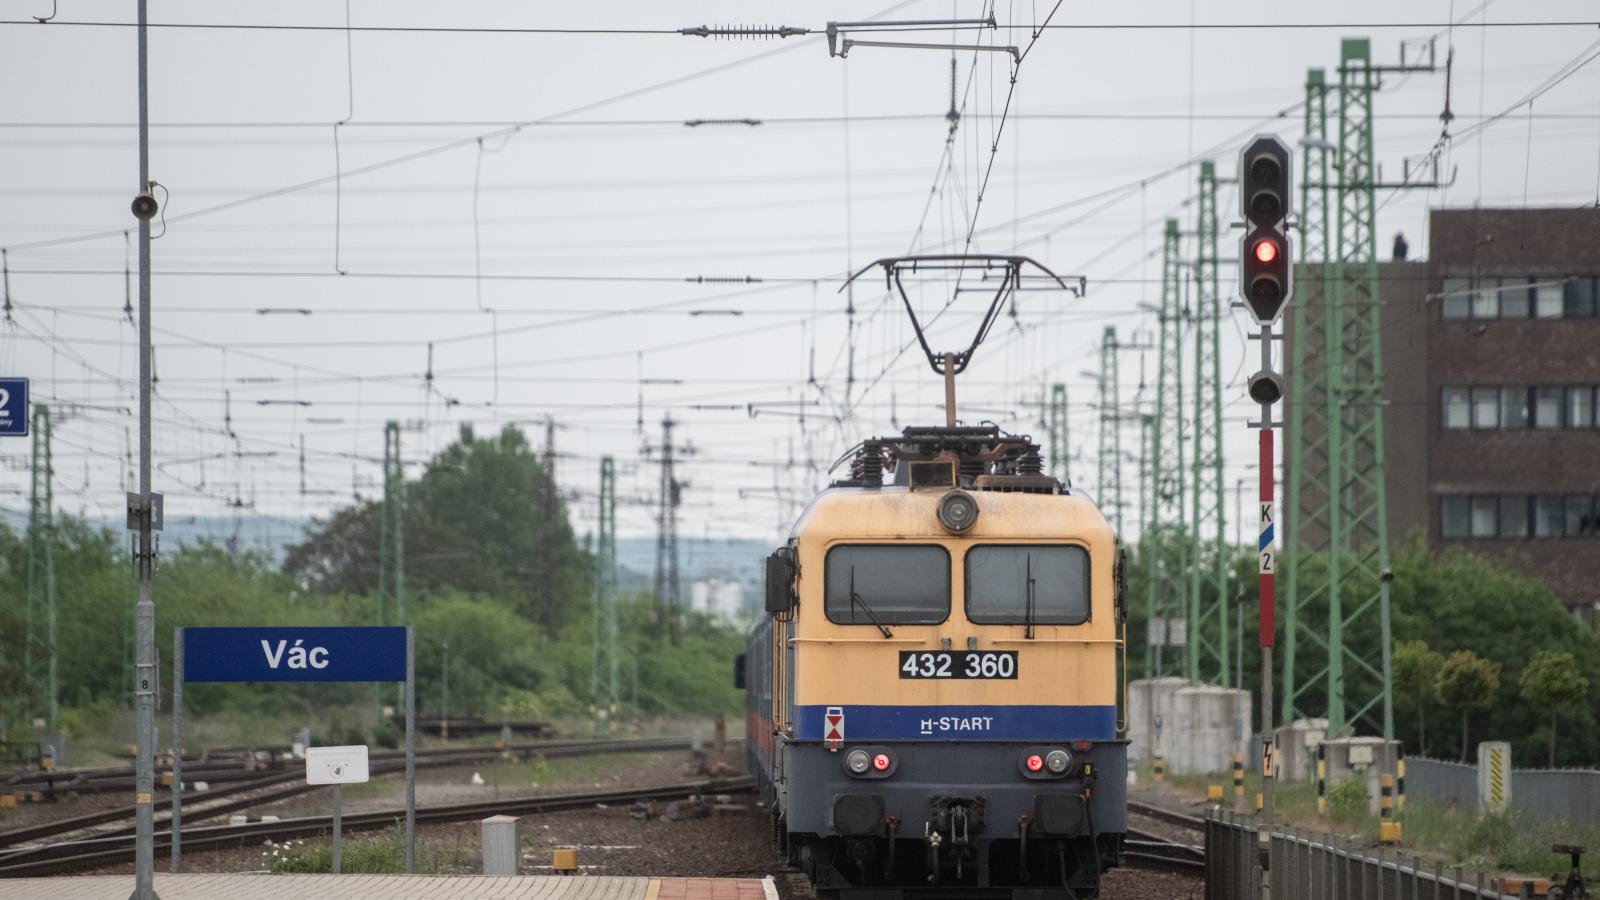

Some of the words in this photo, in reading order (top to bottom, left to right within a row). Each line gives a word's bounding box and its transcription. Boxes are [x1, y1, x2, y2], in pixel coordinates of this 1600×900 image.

[1261, 504, 1271, 522] K
[1263, 552, 1271, 570] 2
[261, 640, 329, 669] Vác
[902, 653, 952, 677] 432
[965, 653, 1014, 677] 360
[142, 680, 148, 689] 8
[921, 717, 993, 733] H-START
